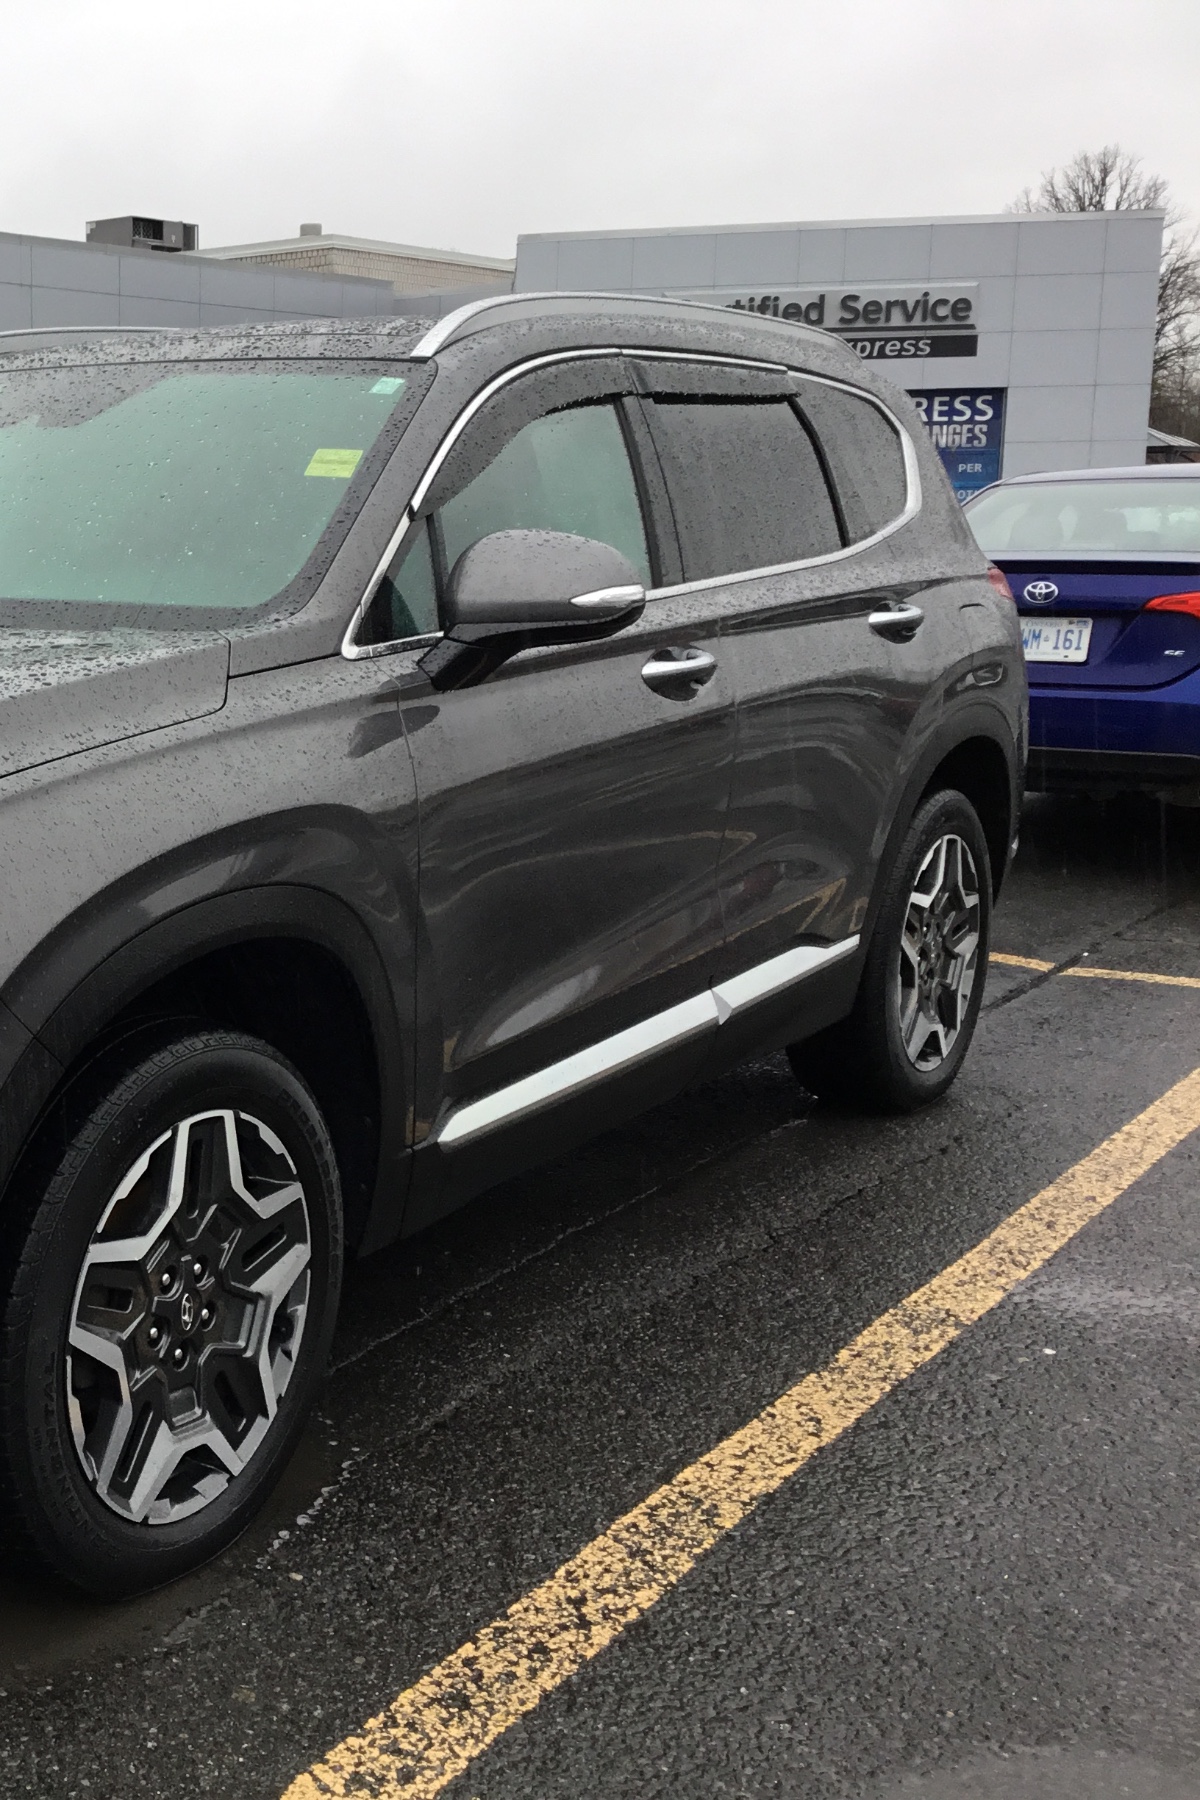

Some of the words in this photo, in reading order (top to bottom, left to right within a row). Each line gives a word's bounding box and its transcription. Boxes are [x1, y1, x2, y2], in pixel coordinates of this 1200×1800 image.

[725, 294, 826, 325] tified
[839, 291, 973, 325] Service
[847, 339, 932, 358] press
[926, 424, 989, 449] NGES
[958, 463, 983, 473] PER
[1052, 629, 1083, 651] 161
